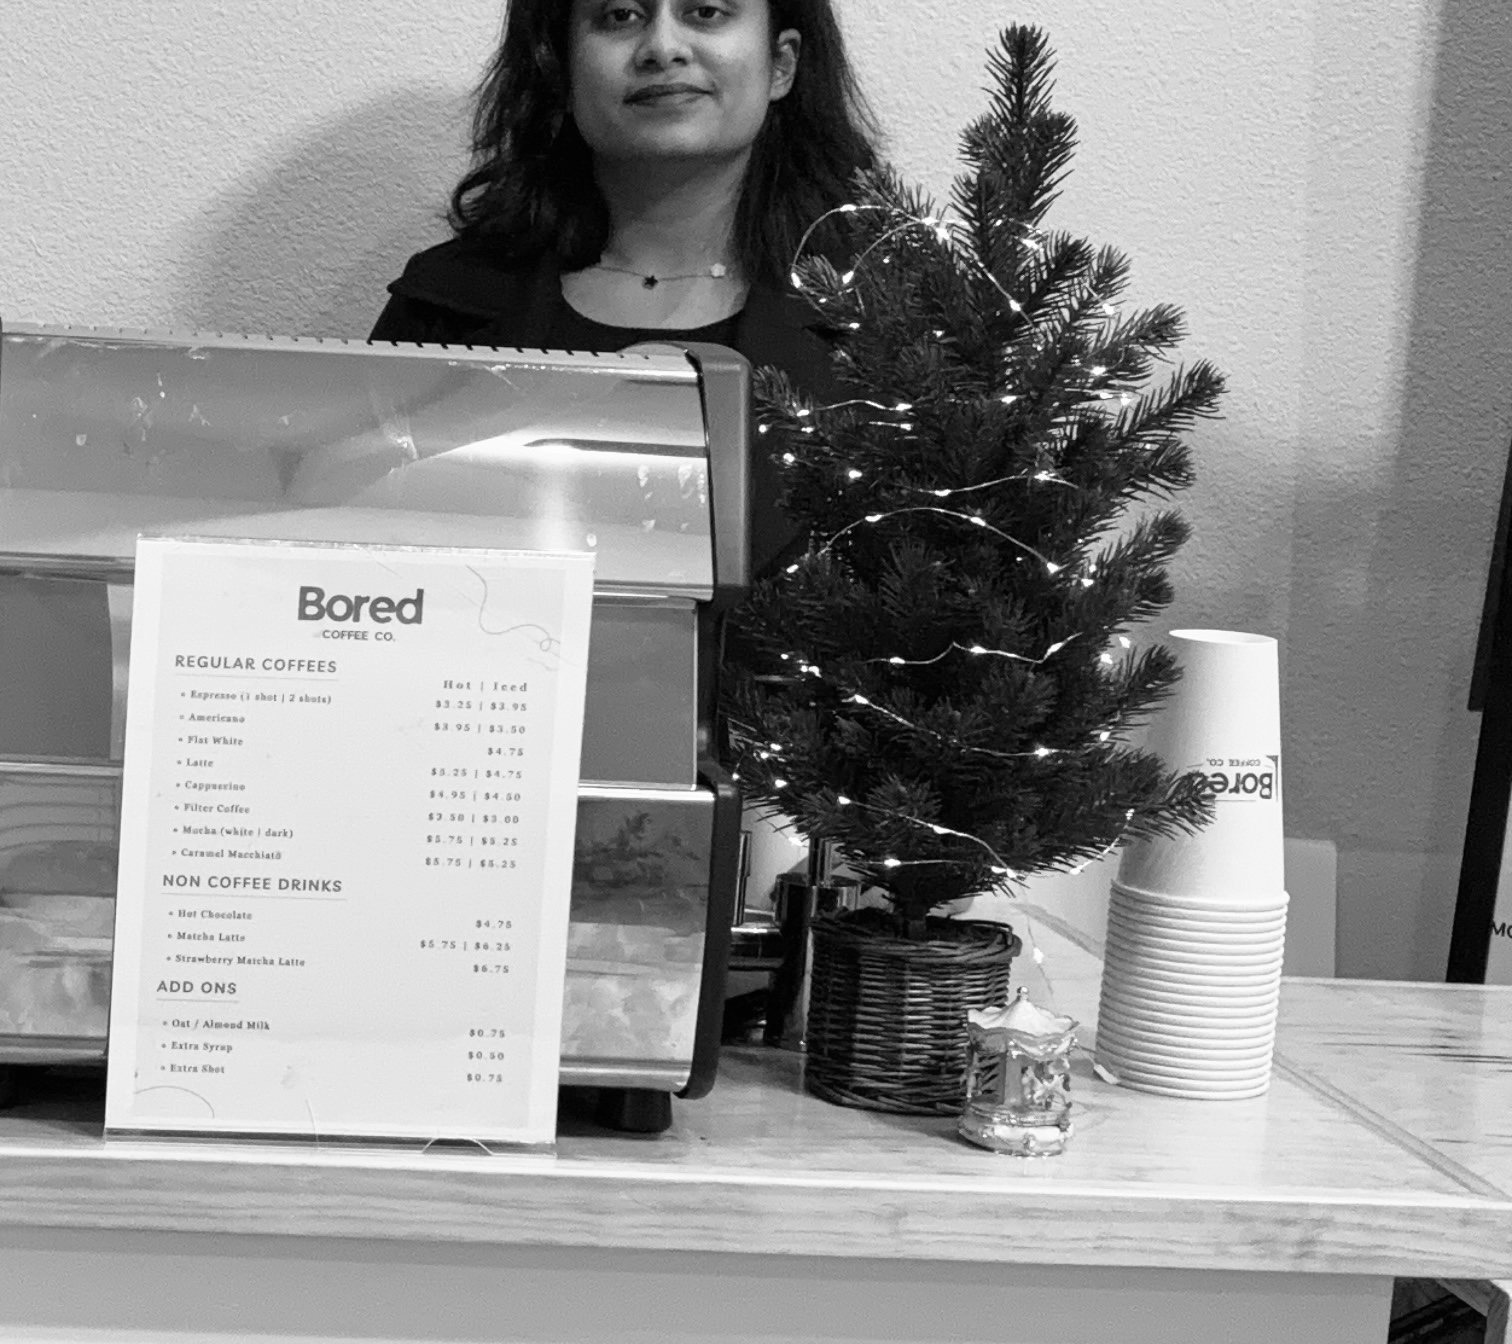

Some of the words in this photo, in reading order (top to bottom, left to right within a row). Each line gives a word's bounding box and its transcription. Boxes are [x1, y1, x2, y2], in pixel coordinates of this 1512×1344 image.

[298, 586, 424, 624] Bored
[322, 630, 368, 640] COFFEE
[375, 632, 395, 641] CO.
[176, 655, 255, 670] REGULAR
[262, 658, 336, 673] COFFEES
[444, 680, 470, 689] Hot
[191, 690, 237, 701] Espresso
[255, 692, 277, 701] shot
[299, 694, 331, 704] shots)
[189, 713, 245, 723] Americano
[188, 736, 208, 744] Flat
[213, 736, 243, 746] White
[488, 747, 523, 756] $4.75
[187, 758, 213, 767] Latte
[486, 770, 521, 779] $4.75
[185, 781, 245, 792] Cappuccino
[184, 803, 213, 812] Filter
[217, 805, 249, 813] Coffee
[183, 826, 216, 835] Mocha
[220, 827, 253, 836] (white
[265, 828, 293, 838] dark)
[181, 848, 224, 857] Caramel
[163, 875, 200, 887] NON
[208, 876, 270, 890] COFFEE
[279, 878, 342, 892] DRINKS
[178, 910, 196, 918] Hot
[201, 910, 252, 920] Chocolate
[476, 920, 511, 928] $4.75
[177, 932, 214, 940] Matcha
[219, 933, 245, 941] Latte
[175, 955, 233, 965] Strawberry
[237, 956, 274, 965] Matcha
[279, 958, 305, 966] Latte
[474, 964, 509, 973] $6.75
[157, 981, 193, 993] ADD
[201, 982, 236, 994] ONS
[172, 1019, 190, 1028] Oat
[203, 1020, 243, 1029] Almond
[247, 1021, 270, 1030] Milk
[469, 1029, 505, 1038] $0.75
[171, 1041, 198, 1050] Extra
[203, 1043, 232, 1053] Syrup
[170, 1064, 198, 1072] Extra
[201, 1065, 224, 1073] Shot
[467, 1073, 502, 1082] $0.75
